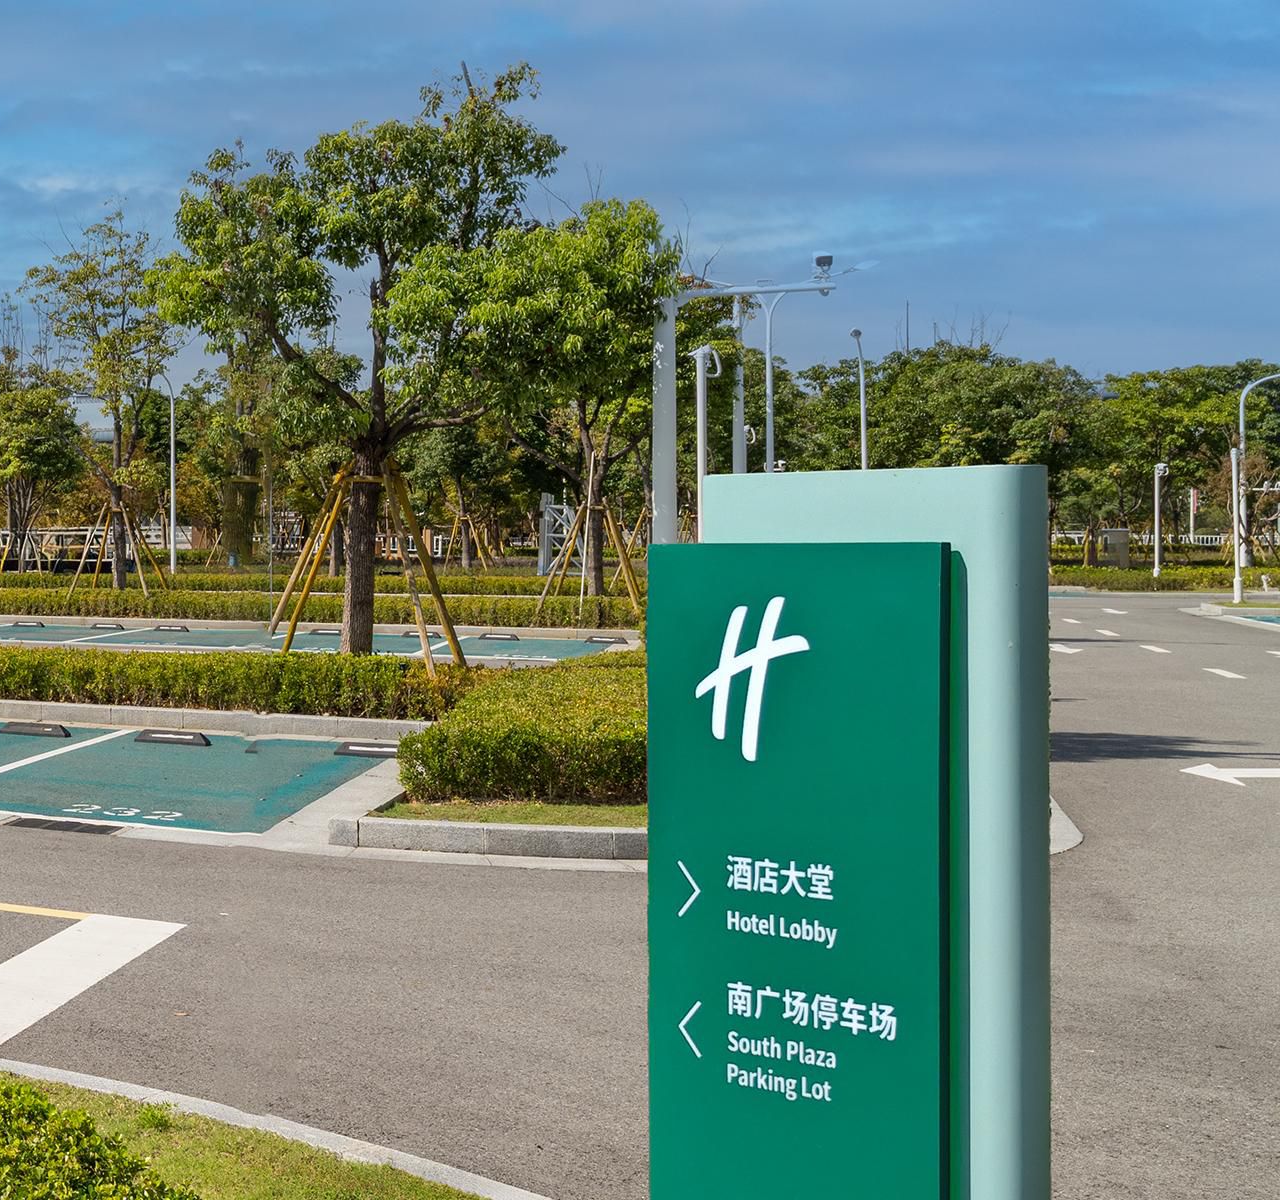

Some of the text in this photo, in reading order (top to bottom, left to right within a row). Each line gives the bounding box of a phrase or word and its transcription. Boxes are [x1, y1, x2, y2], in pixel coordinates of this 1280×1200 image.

[695, 596, 810, 762] H
[61, 803, 183, 821] 232
[726, 855, 834, 901] 酒店大堂
[726, 910, 838, 949] Hotel Lobby
[727, 981, 897, 1041] 南广场停车场
[727, 1030, 837, 1069] South Plaza
[726, 1063, 832, 1102] Parking Lot
